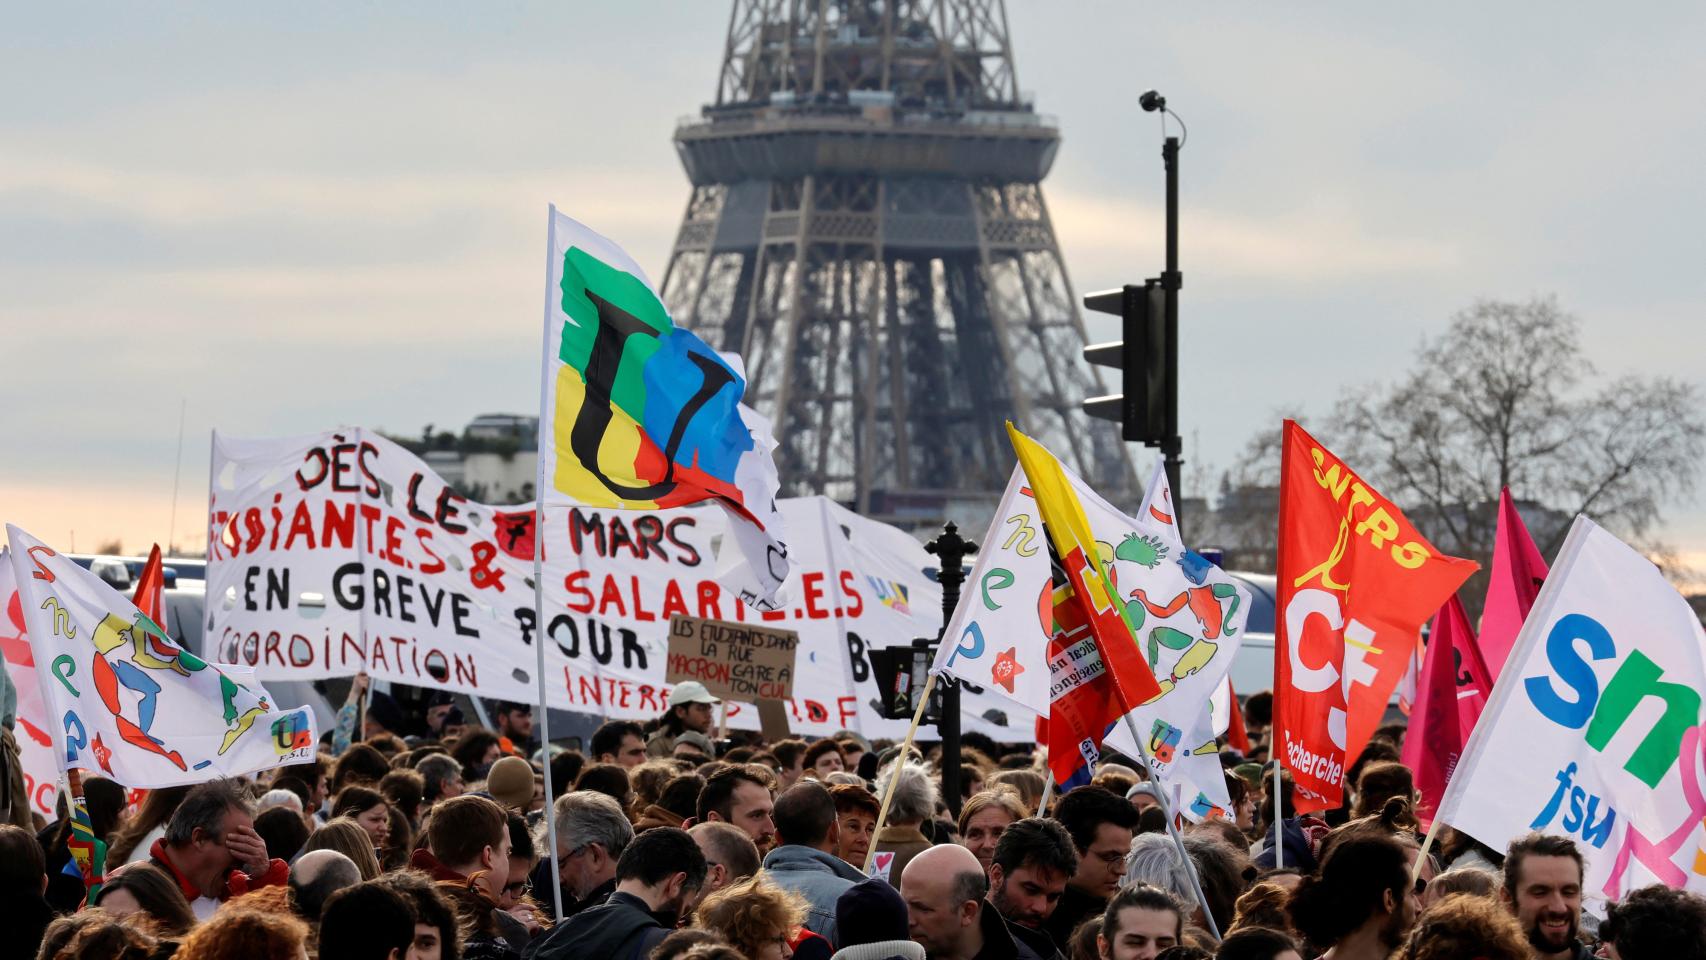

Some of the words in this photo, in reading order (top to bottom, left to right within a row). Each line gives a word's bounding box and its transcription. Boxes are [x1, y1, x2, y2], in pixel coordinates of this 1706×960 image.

[407, 473, 468, 534] LE
[506, 515, 530, 551] 7
[568, 507, 701, 567] MARS
[470, 541, 506, 592] &
[245, 566, 290, 611] EN
[332, 562, 480, 638] GREVE
[513, 607, 648, 669] POUR
[673, 618, 694, 638] LES
[767, 634, 797, 651] DANS
[668, 652, 729, 684] MACRON
[732, 664, 775, 681] GARE
[701, 640, 717, 656] LA
[728, 644, 755, 662] RUE
[729, 677, 759, 694] TON
[760, 683, 793, 699] CUL
[1285, 729, 1341, 785] echerche
